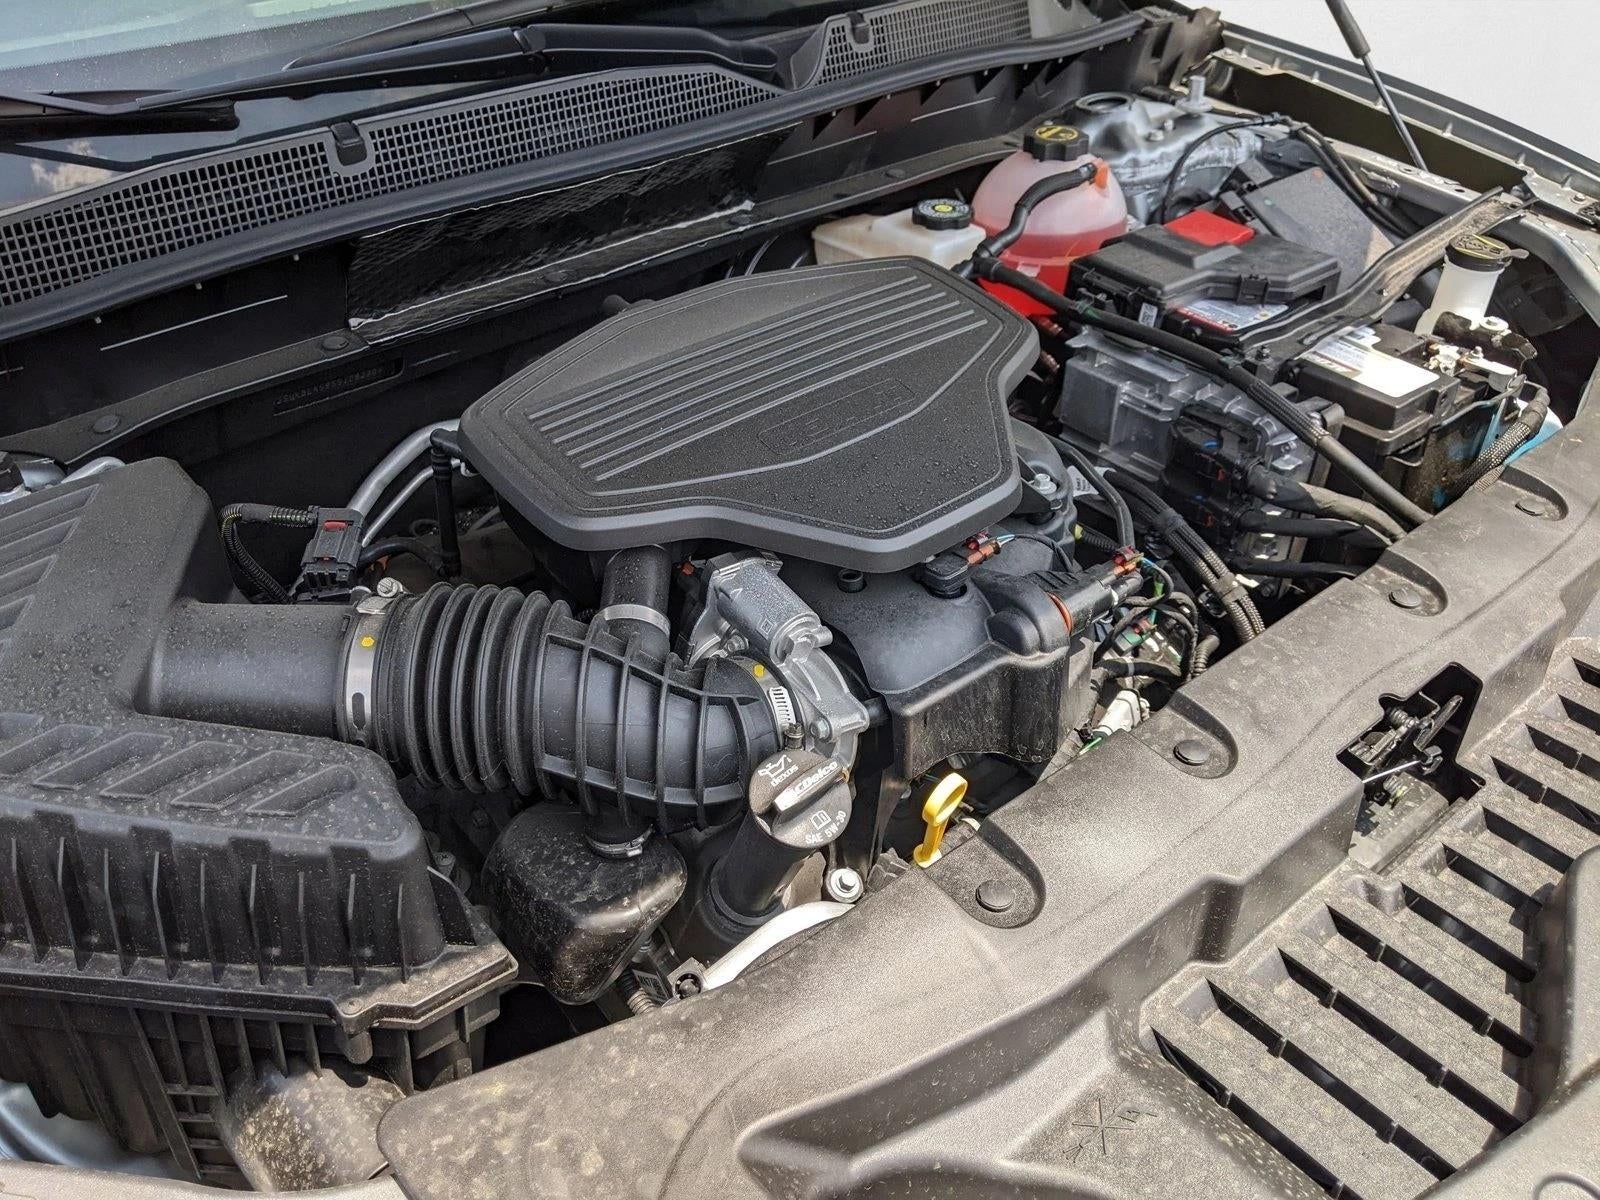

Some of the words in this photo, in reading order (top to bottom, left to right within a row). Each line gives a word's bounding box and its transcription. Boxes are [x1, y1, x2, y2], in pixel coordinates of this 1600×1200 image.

[771, 764, 799, 787] dexos
[804, 834, 824, 844] SAE
[824, 810, 847, 838] 5W-30
